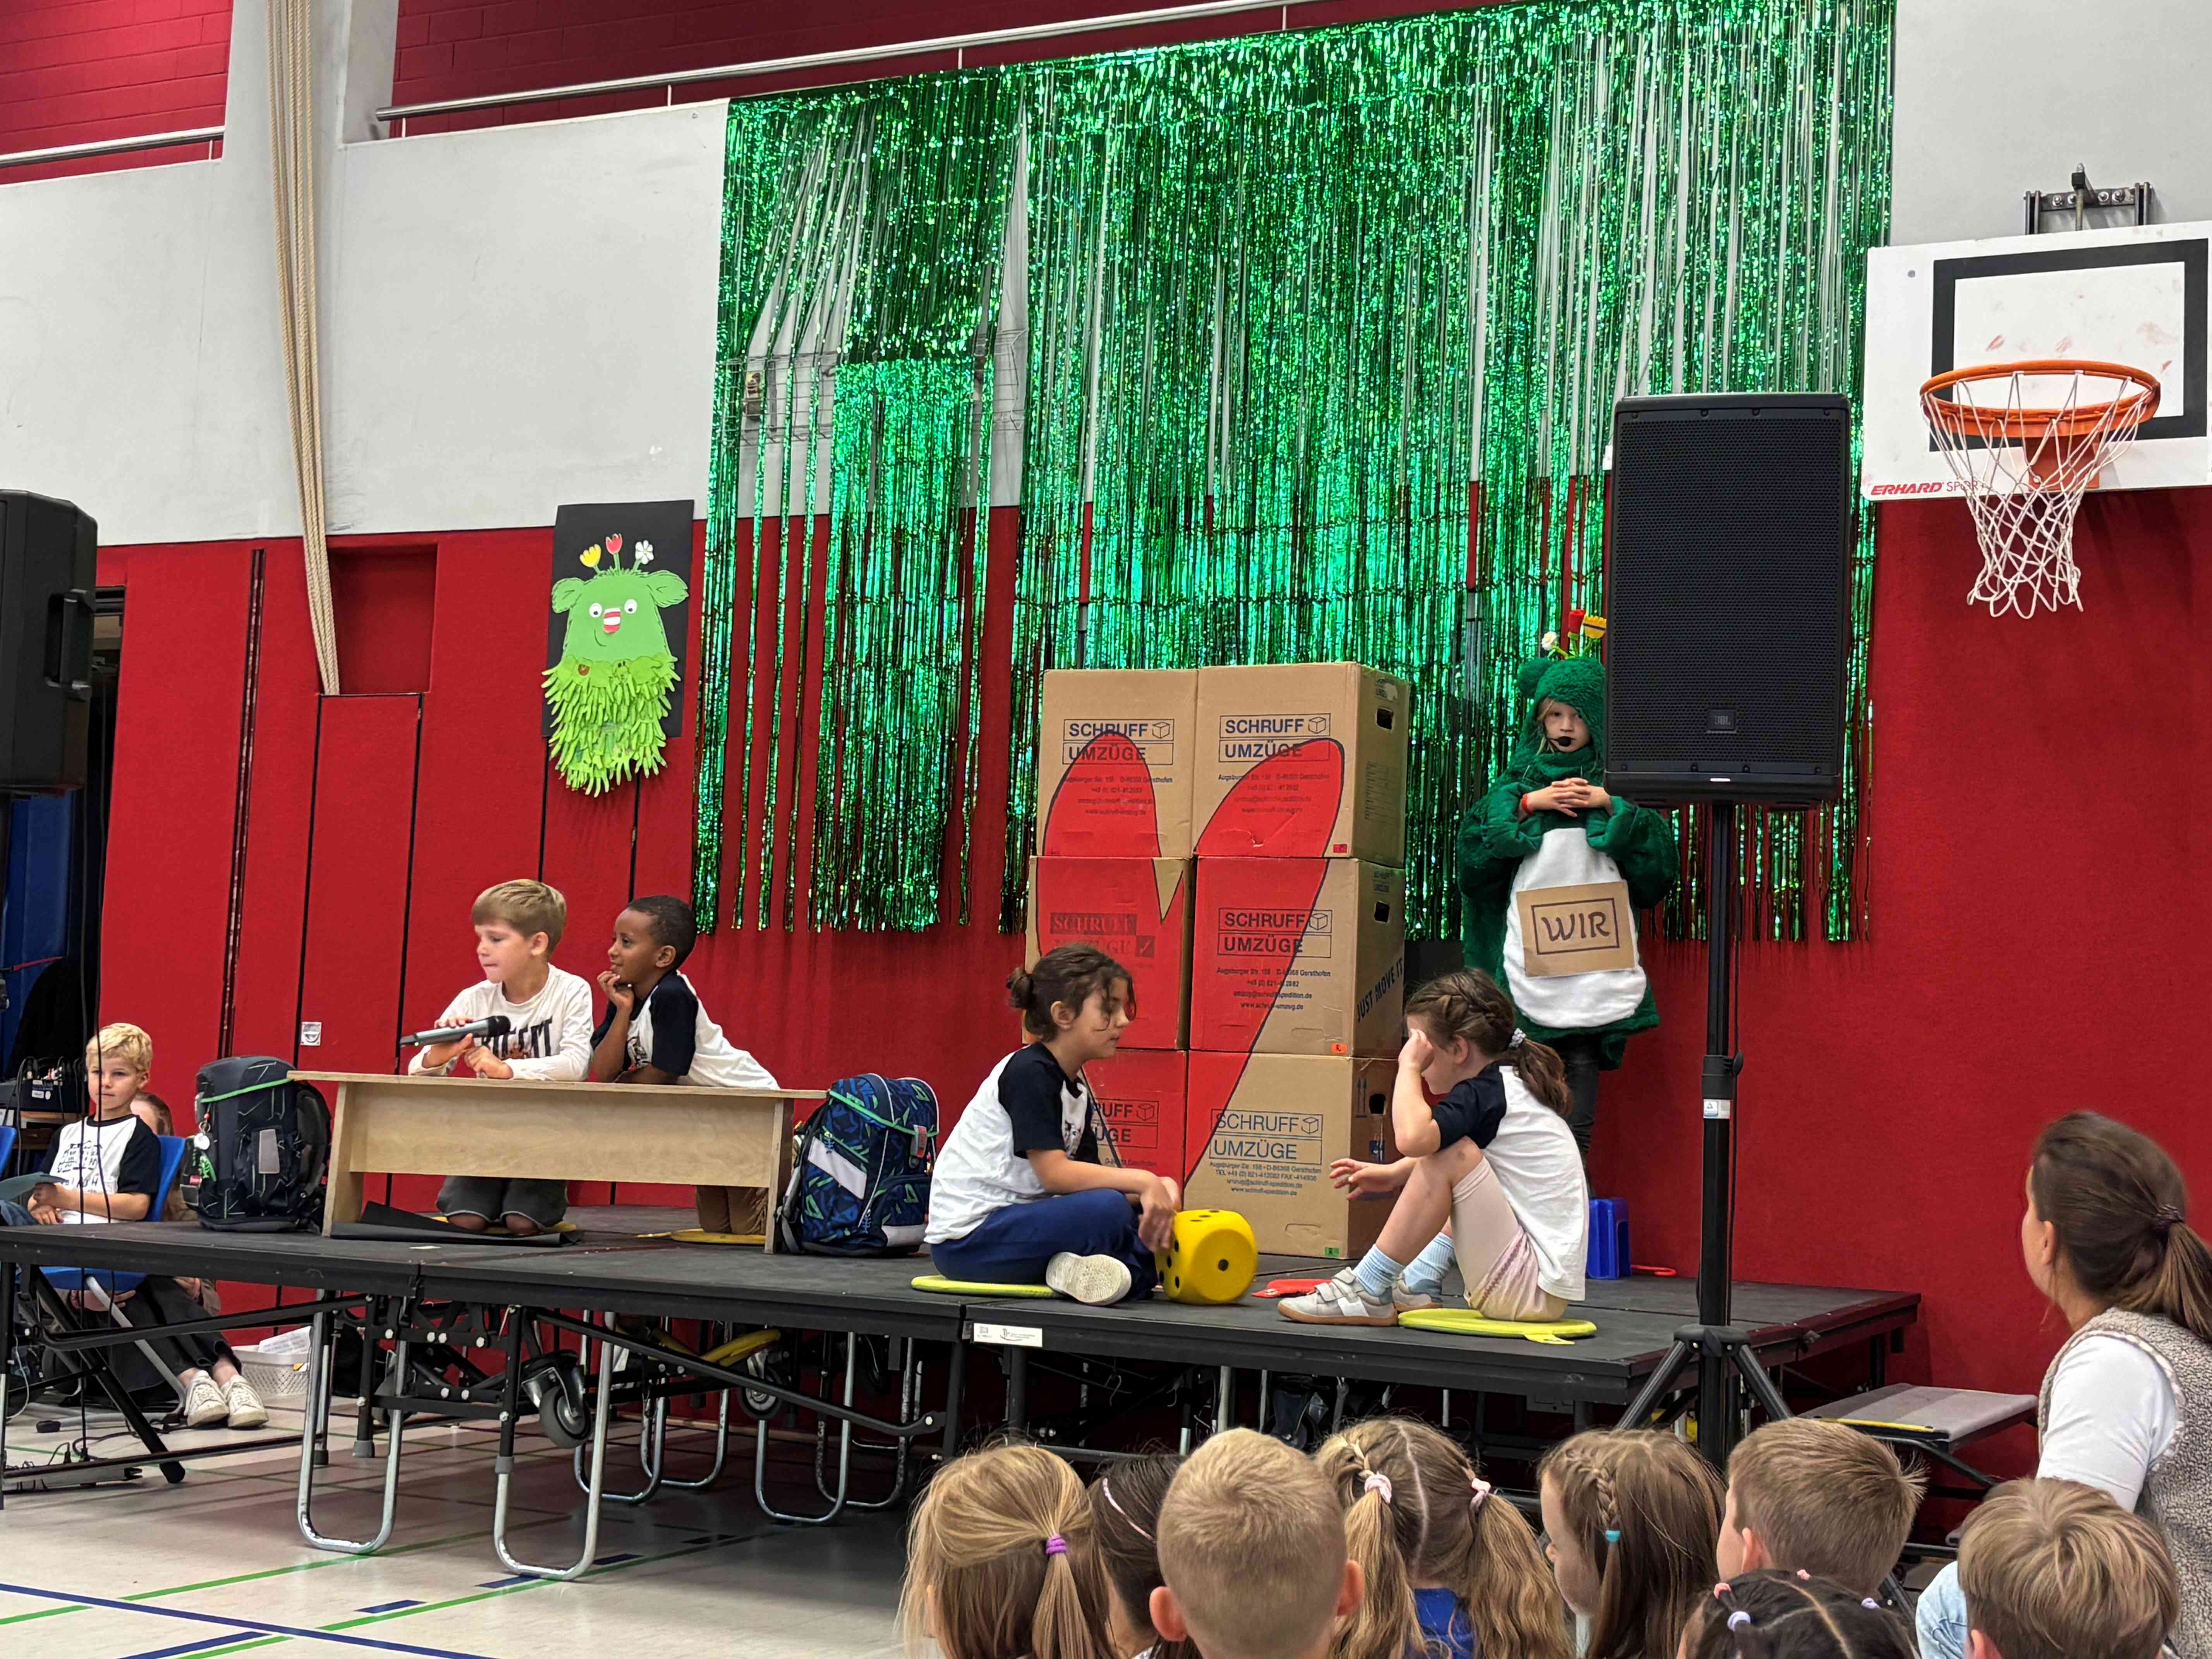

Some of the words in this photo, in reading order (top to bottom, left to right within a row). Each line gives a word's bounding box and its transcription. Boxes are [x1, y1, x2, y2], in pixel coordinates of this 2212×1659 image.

[1871, 483, 1942, 495] ERHARD
[1946, 480, 1984, 491] SPOR
[1225, 718, 1304, 733] SCHRUFF
[1714, 716, 1731, 725] JBL
[1069, 723, 1148, 737] SCHRUFF
[1069, 743, 1146, 761] UMZÜGE
[1225, 739, 1302, 758] UMZÜGE
[1224, 912, 1305, 928] SCHRUFF
[1541, 911, 1610, 941] WIR
[1224, 934, 1303, 953] UMZÜGE
[1357, 990, 1373, 1023] JUST
[1375, 965, 1395, 1003] MOVE
[1396, 957, 1403, 978] IT
[1216, 1113, 1299, 1132] SCHRUFF
[1214, 1139, 1297, 1160] UMZÜGE
